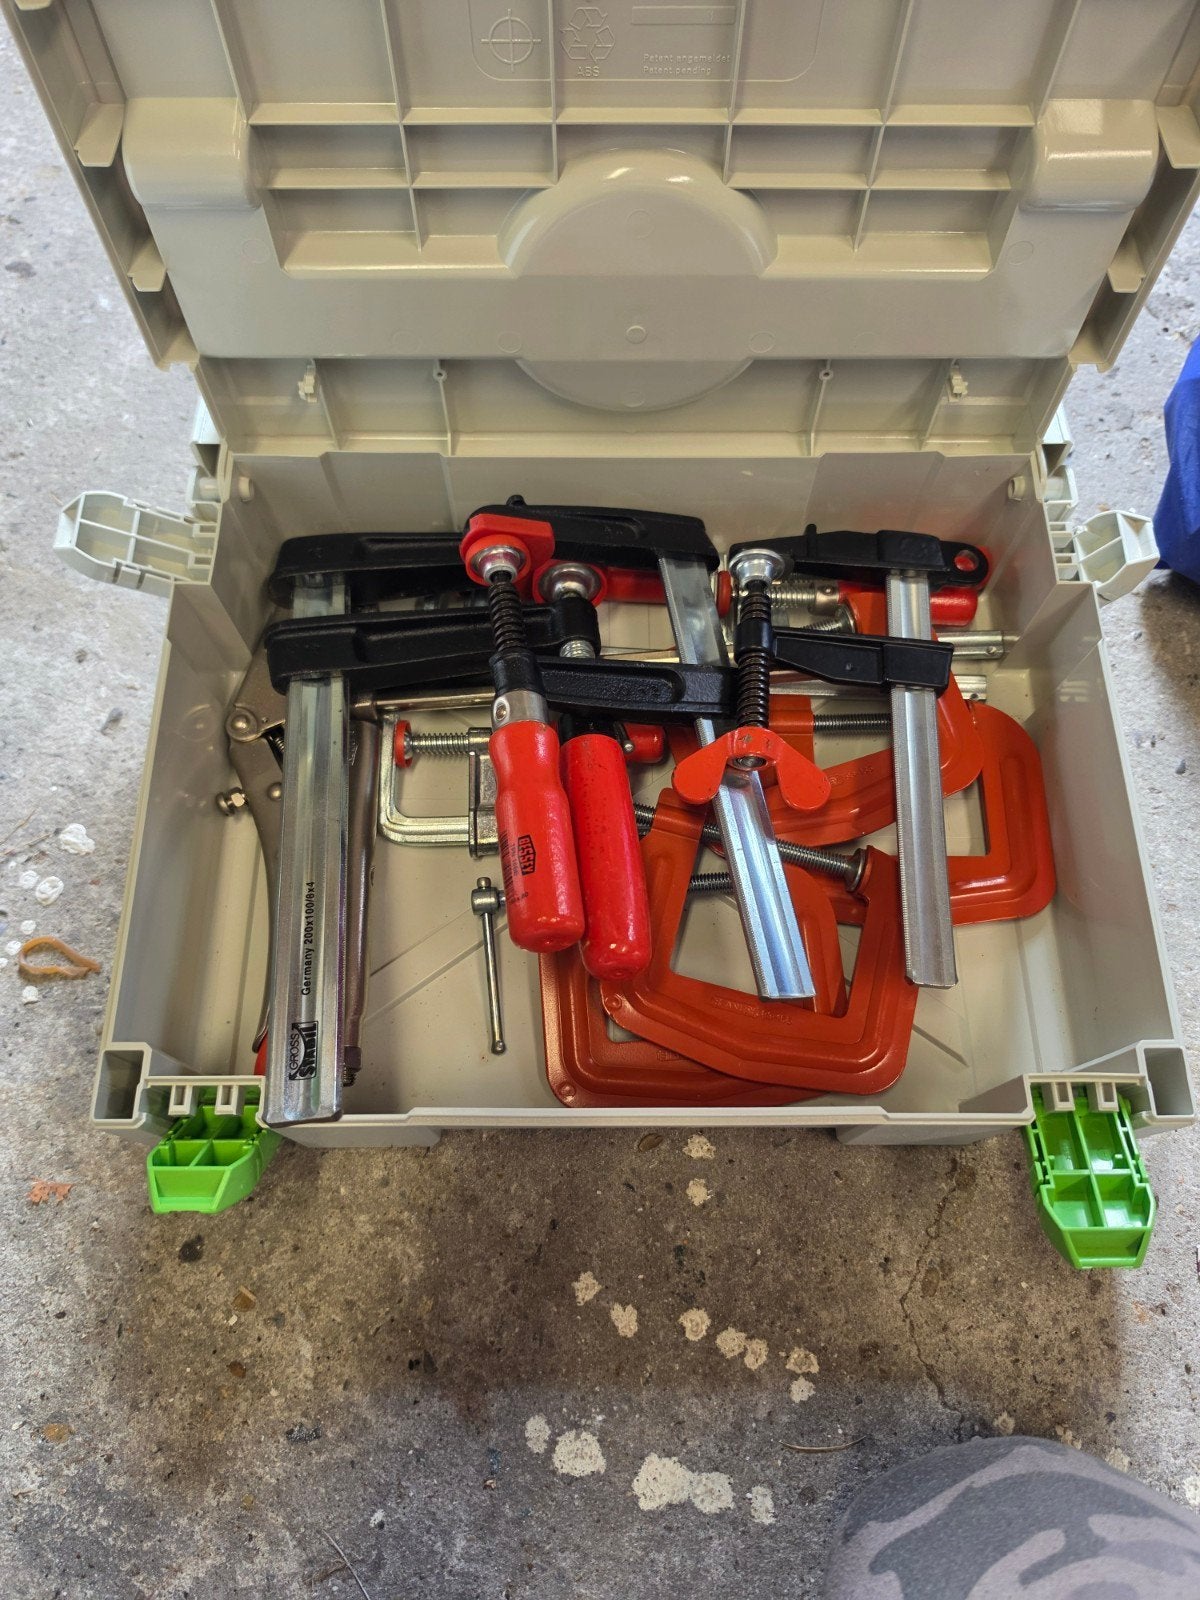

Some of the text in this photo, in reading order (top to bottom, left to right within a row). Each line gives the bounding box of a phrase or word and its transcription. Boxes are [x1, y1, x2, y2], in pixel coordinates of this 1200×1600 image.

[643, 53, 673, 63] Patent
[575, 66, 600, 77] ABS
[643, 65, 712, 76] Patent pending
[518, 837, 536, 875] BESSEY
[301, 881, 315, 996] Germany 200x100/8x4
[289, 1033, 300, 1071] GROSS
